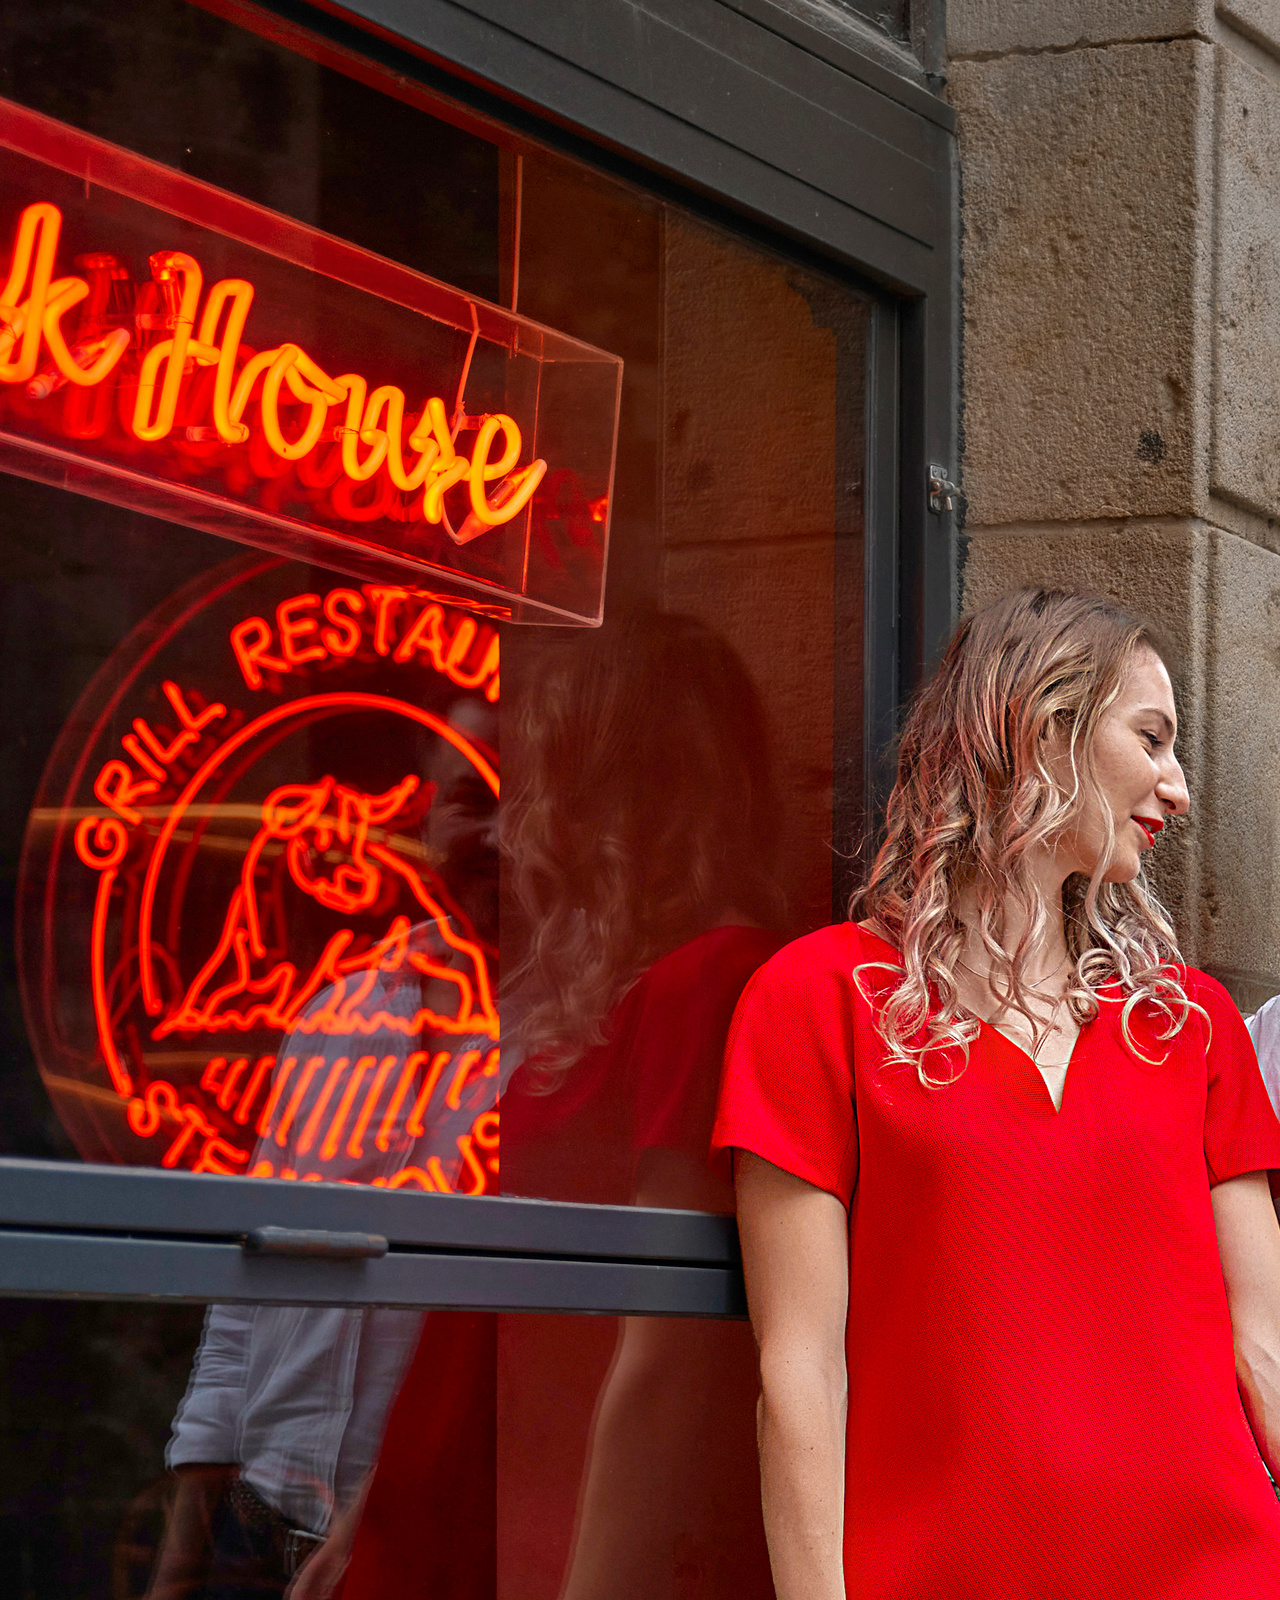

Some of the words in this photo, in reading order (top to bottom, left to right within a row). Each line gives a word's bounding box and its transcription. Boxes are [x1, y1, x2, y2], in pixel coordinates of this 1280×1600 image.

[0, 202, 131, 386] k
[132, 250, 547, 526] House
[74, 679, 227, 870] GRILL
[230, 584, 500, 703] RESTAU
